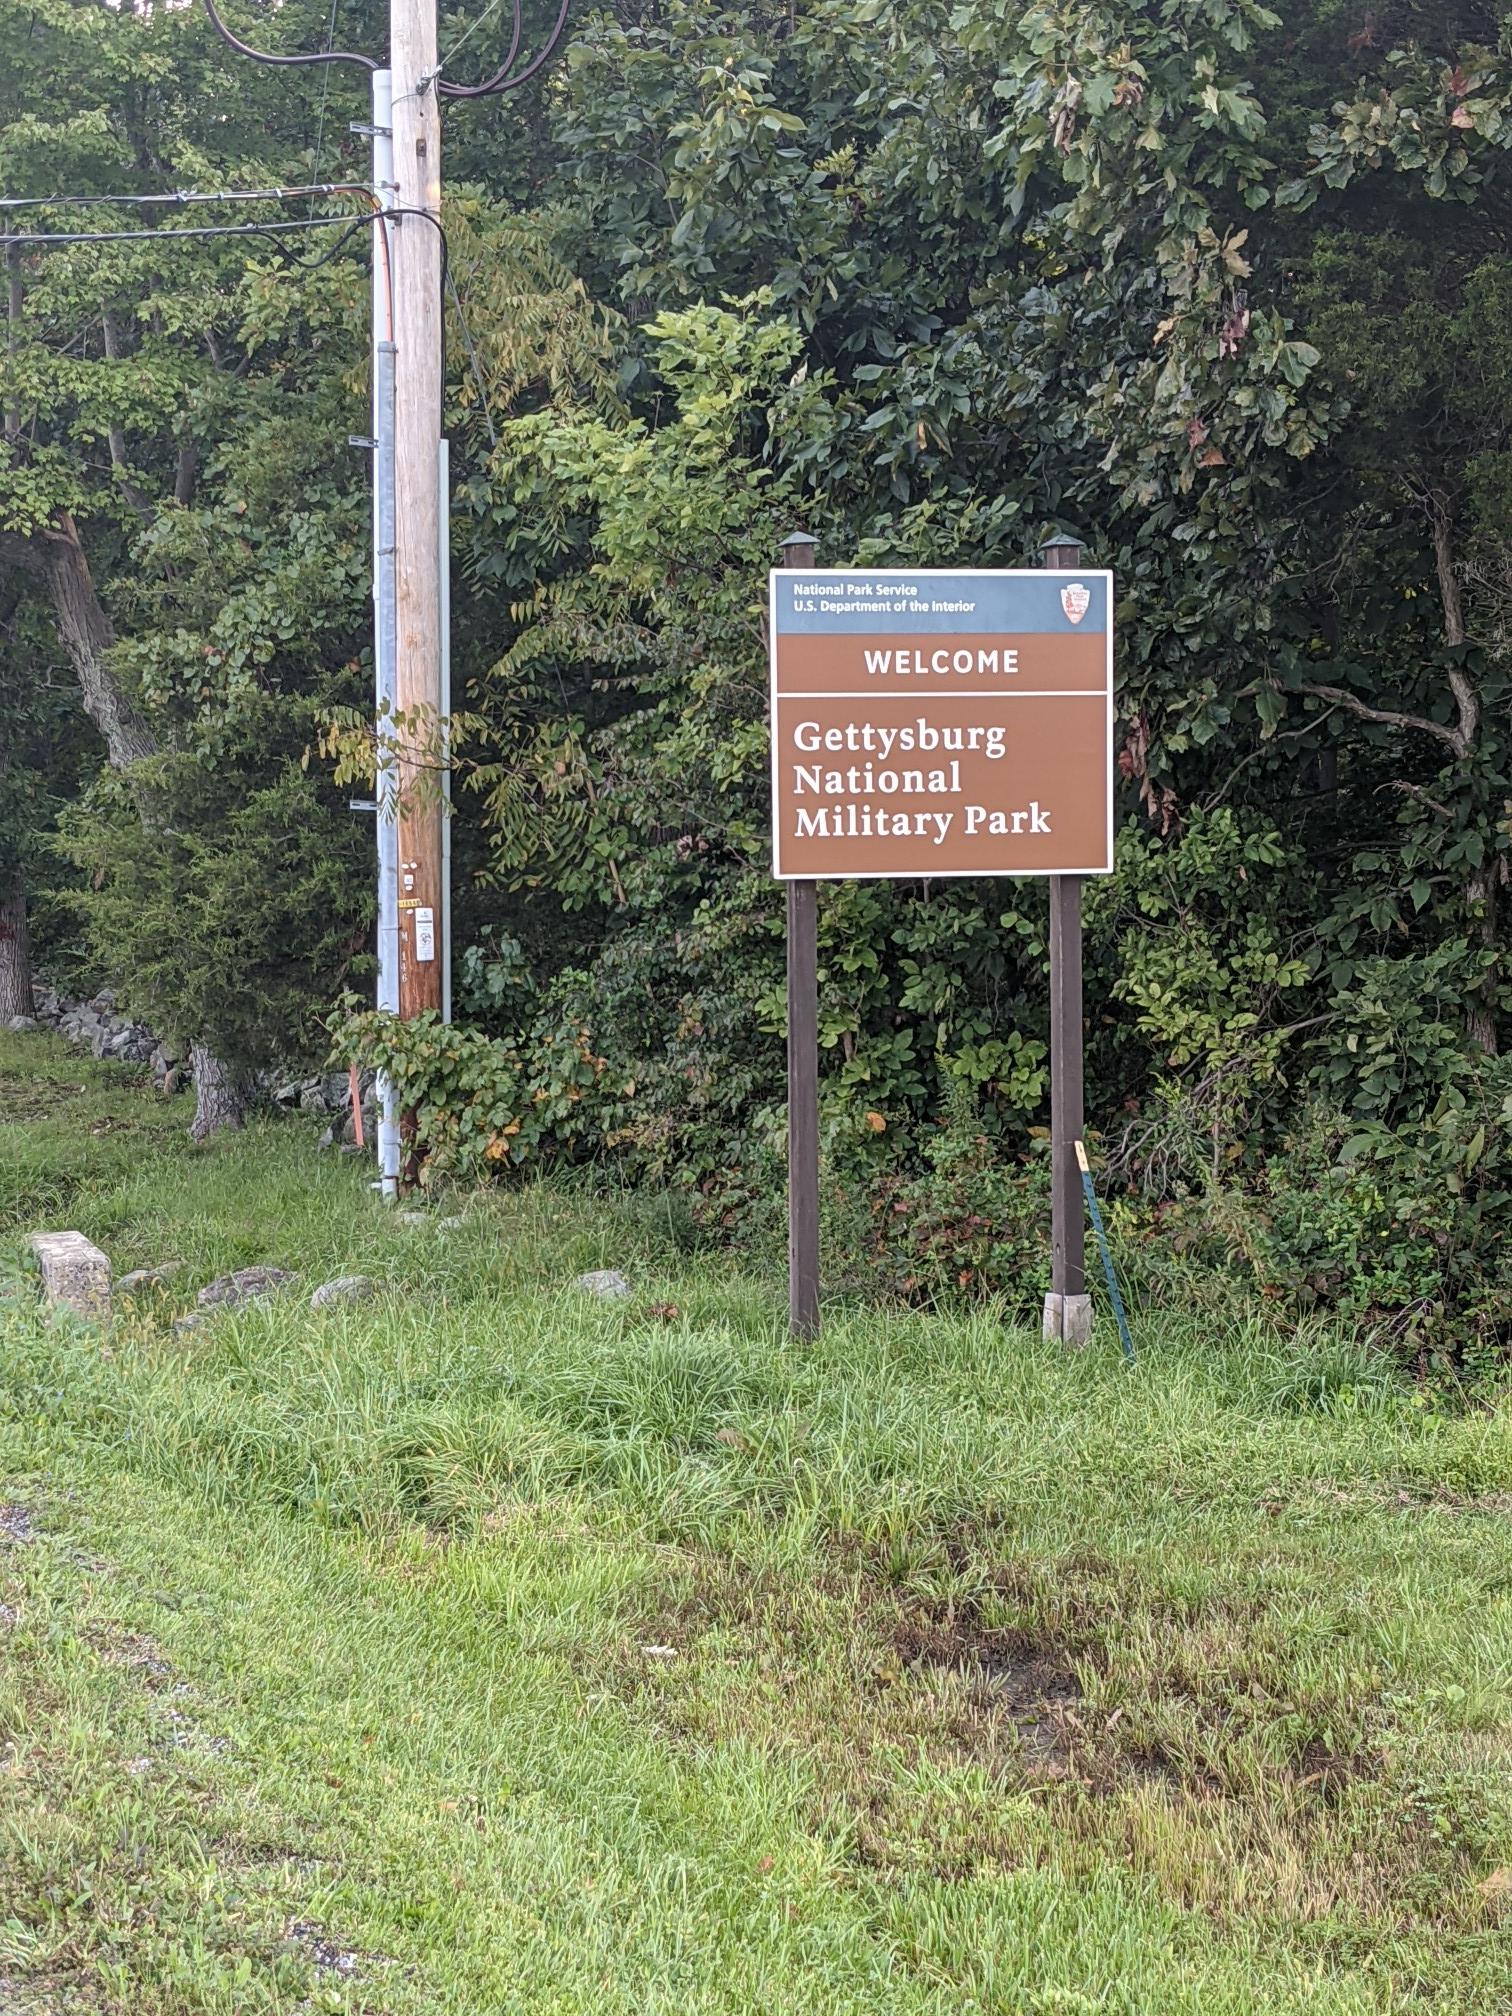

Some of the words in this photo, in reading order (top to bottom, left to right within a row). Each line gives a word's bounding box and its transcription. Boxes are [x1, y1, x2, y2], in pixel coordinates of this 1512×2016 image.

[794, 584, 843, 595] National
[848, 584, 872, 595] Park
[876, 584, 917, 595] Service
[794, 601, 817, 611] U.S.
[821, 601, 891, 614] Department
[894, 600, 906, 611] of
[910, 600, 929, 611] the
[932, 600, 975, 611] Interior
[864, 650, 1018, 673] WELCOME
[794, 719, 1005, 759] Gettysburg
[794, 761, 961, 793] National
[795, 805, 953, 844] Military
[965, 802, 1051, 834] Park
